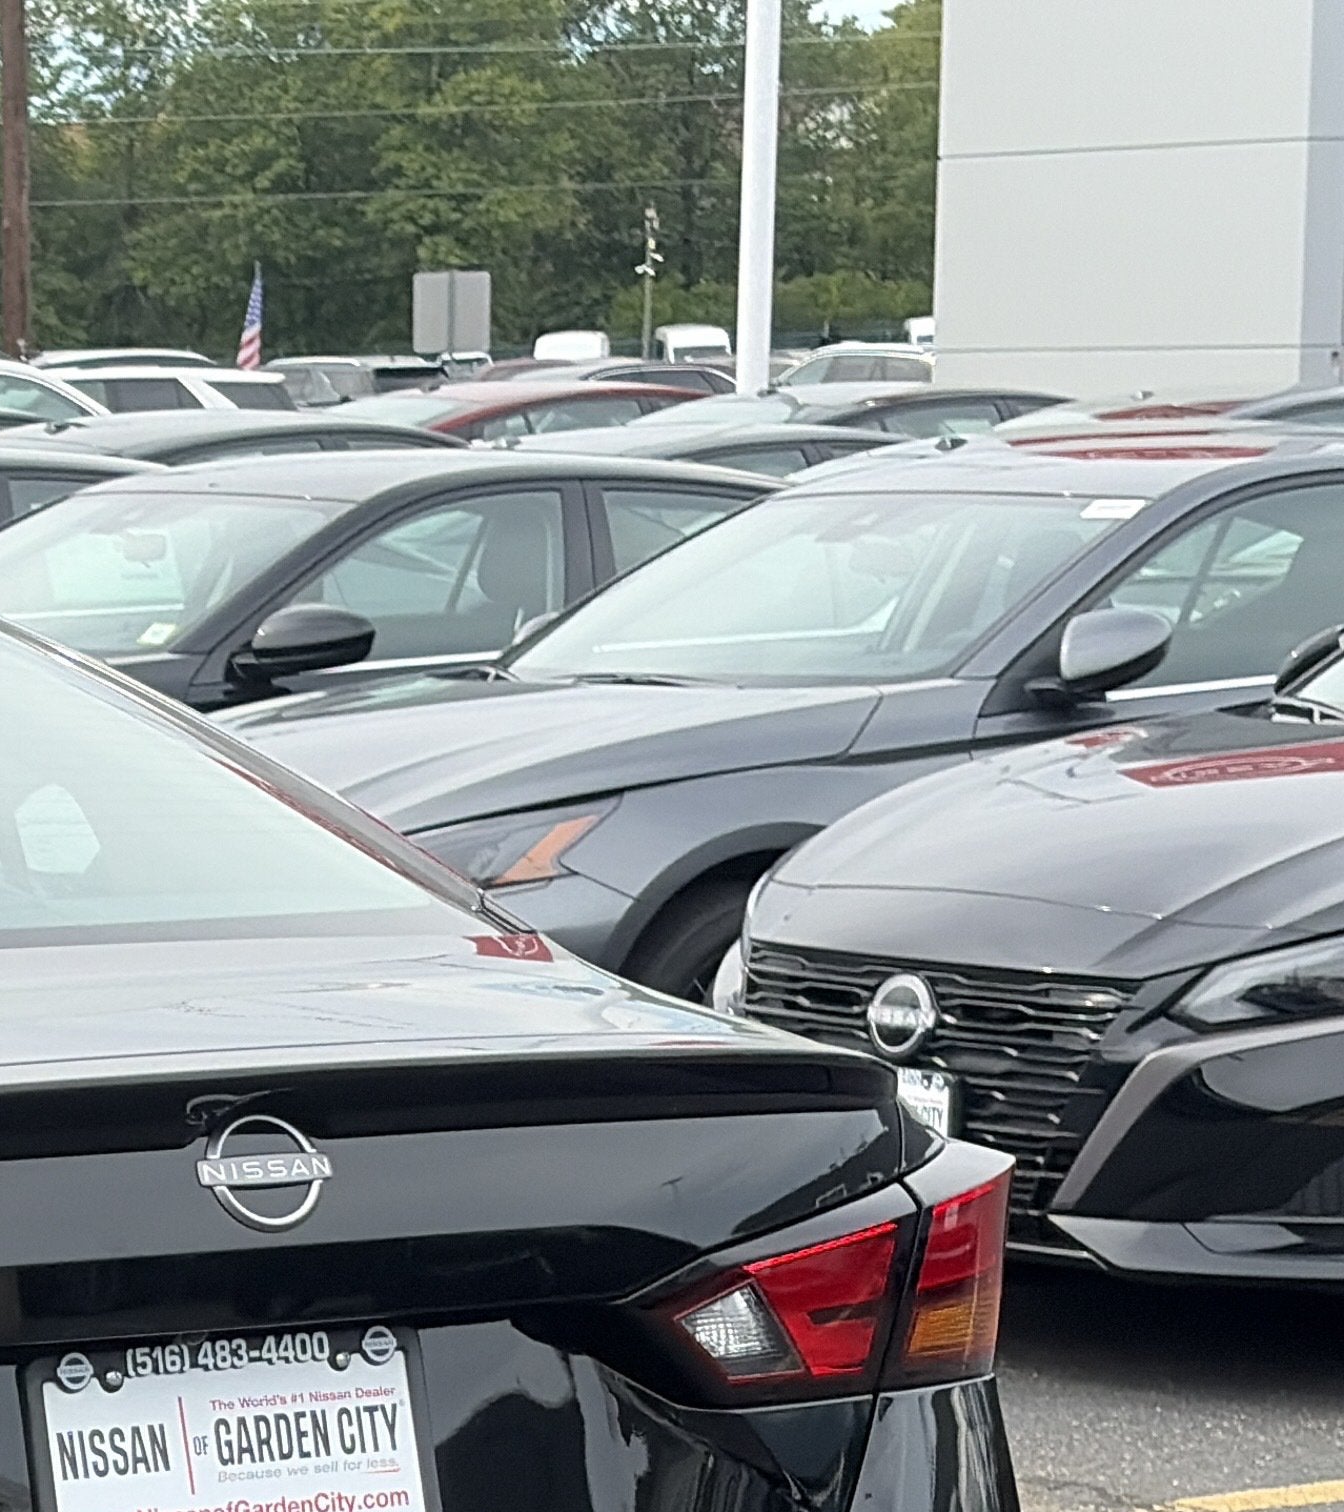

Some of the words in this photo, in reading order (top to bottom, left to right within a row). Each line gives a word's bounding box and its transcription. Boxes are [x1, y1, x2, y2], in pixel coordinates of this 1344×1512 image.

[199, 1154, 332, 1184] NISSAN
[126, 1344, 190, 1378] (516)
[197, 1331, 330, 1368] 483-4400
[209, 1398, 235, 1412] The
[238, 1393, 287, 1410] World's
[291, 1391, 305, 1405] #1
[308, 1388, 351, 1404] Nissan
[355, 1384, 396, 1400] Dealer
[55, 1423, 172, 1482] NISSAN
[193, 1435, 209, 1456] OF
[214, 1409, 331, 1466] GARDEN
[337, 1403, 399, 1456] CITY
[217, 1467, 282, 1483] Because
[286, 1464, 309, 1477] we
[313, 1458, 339, 1474] sell
[342, 1458, 363, 1473] for
